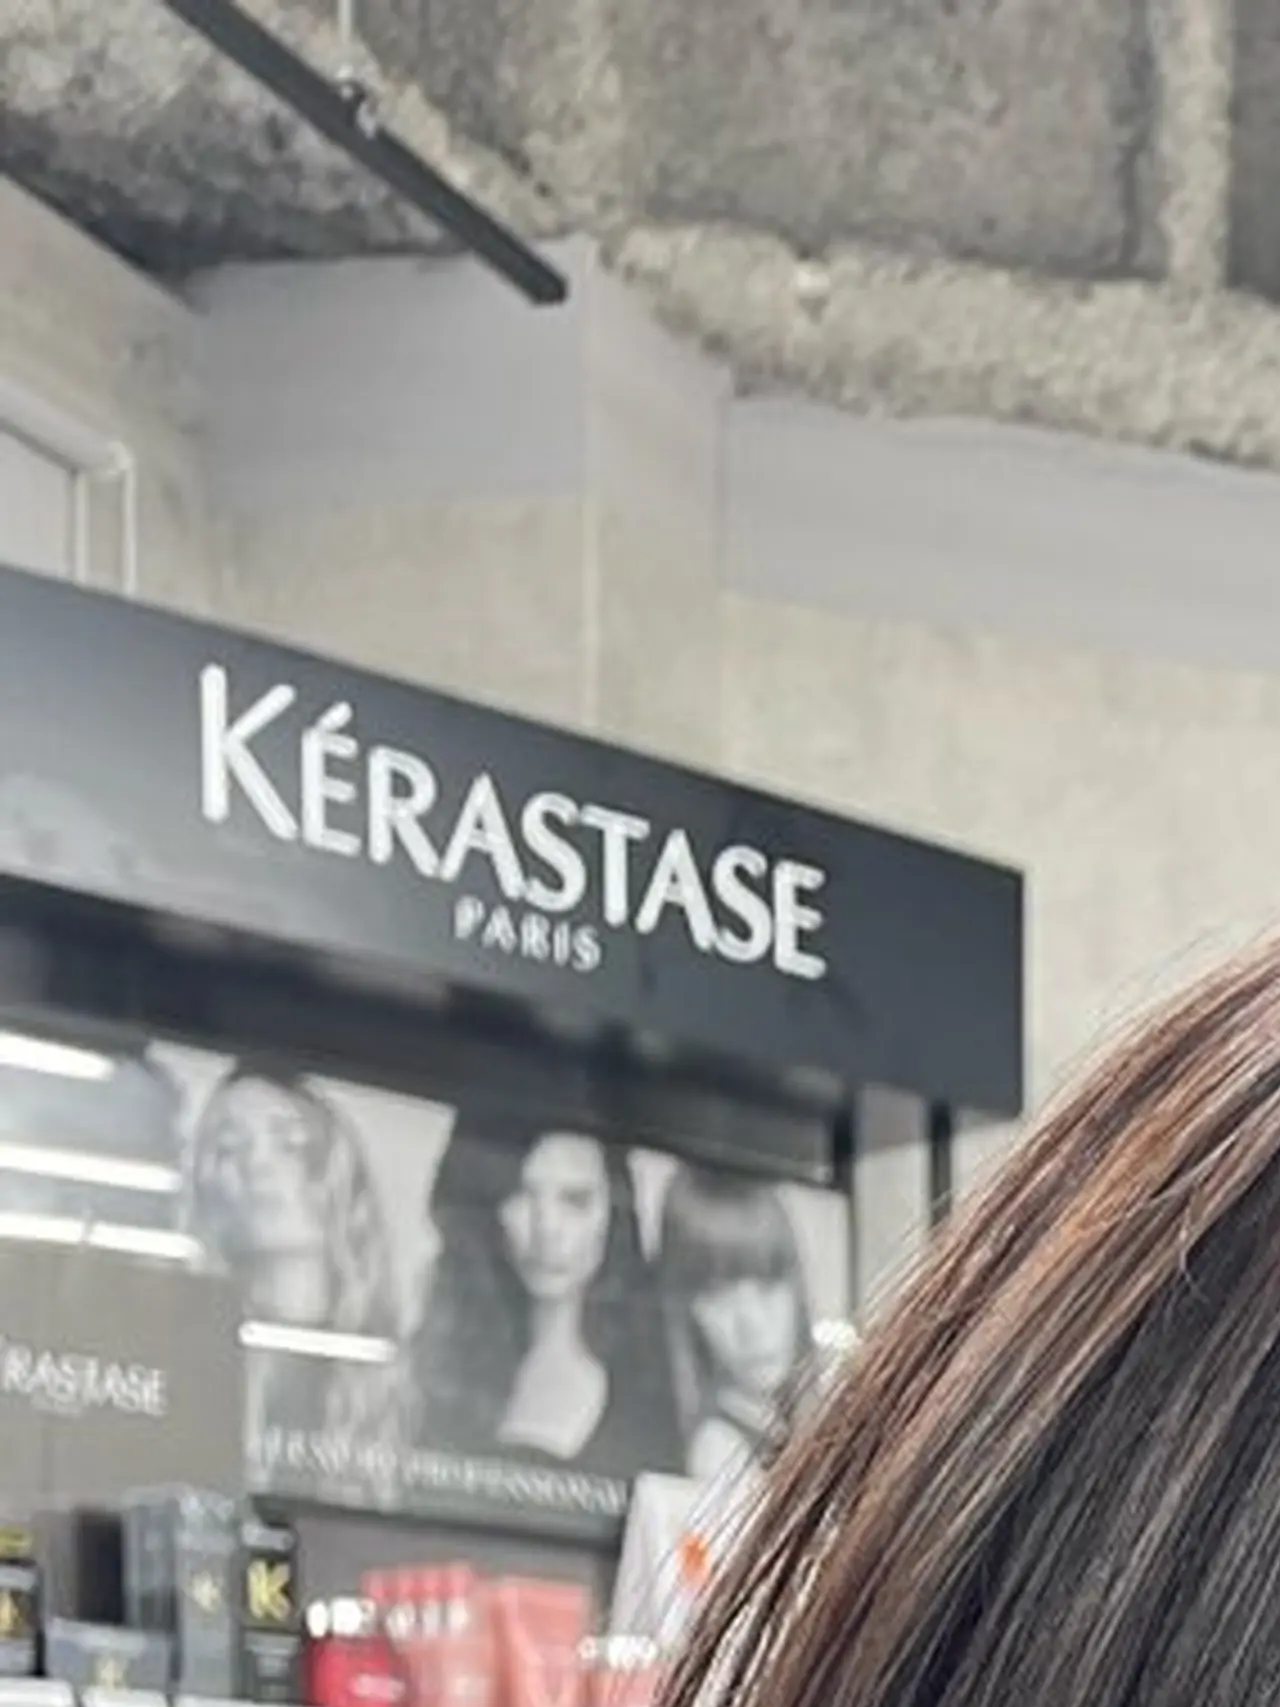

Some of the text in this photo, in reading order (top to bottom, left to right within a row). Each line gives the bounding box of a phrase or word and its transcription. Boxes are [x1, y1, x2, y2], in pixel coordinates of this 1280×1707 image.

[200, 664, 827, 980] KÉRASTASE
[455, 896, 601, 973] PARIS
[0, 1344, 168, 1417] RASTASE
[247, 1558, 293, 1621] K
